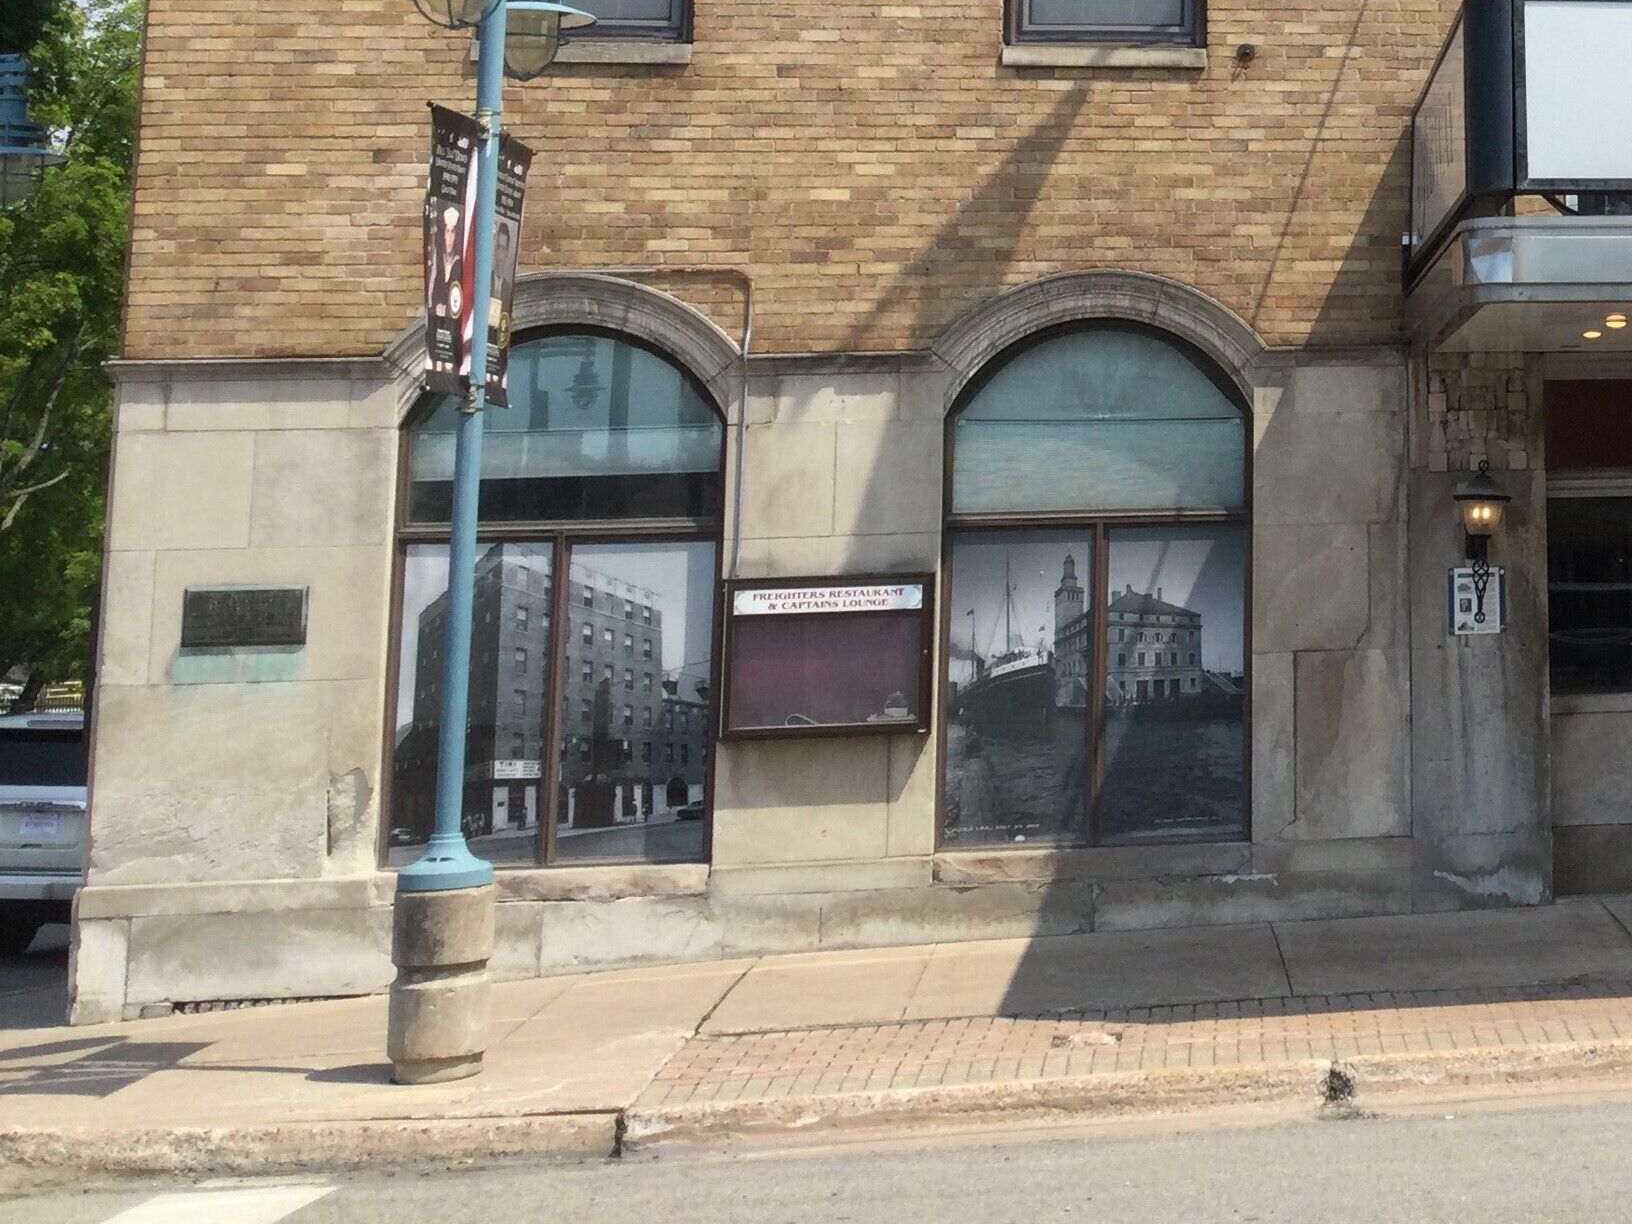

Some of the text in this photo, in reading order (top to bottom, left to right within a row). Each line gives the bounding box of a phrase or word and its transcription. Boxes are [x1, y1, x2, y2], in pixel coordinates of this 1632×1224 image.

[752, 587, 905, 601] FREIGHTERS RESTAURANT
[767, 598, 889, 611] & CAPTAINS LOUNGE
